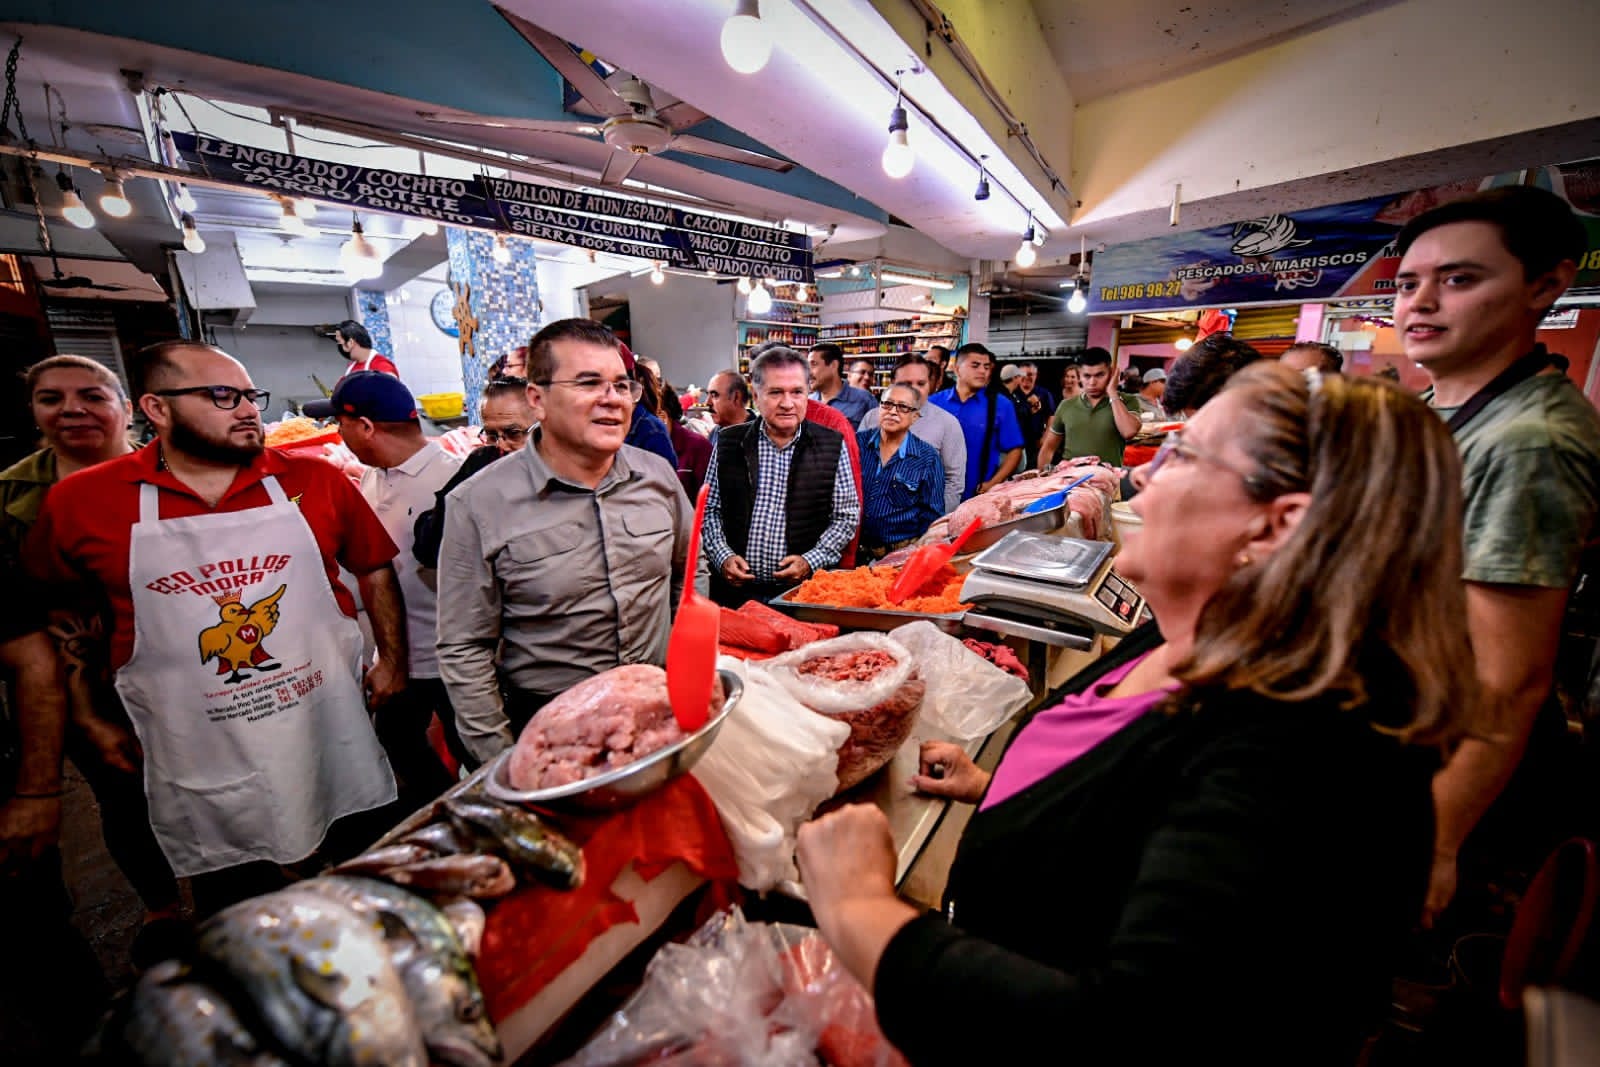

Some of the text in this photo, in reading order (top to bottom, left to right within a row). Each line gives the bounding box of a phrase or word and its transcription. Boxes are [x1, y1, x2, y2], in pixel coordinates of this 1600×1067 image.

[200, 139, 347, 180] LENGUADO
[366, 170, 467, 197] COCHITO
[244, 173, 351, 201] PARGO
[366, 197, 474, 225] BURRITO
[356, 183, 461, 212] BOTETE
[564, 192, 582, 210] DE
[511, 221, 576, 245] SIERRA
[580, 235, 616, 253] 100%
[741, 226, 790, 245] BOTETE
[737, 243, 791, 263] BURRITO
[1177, 263, 1254, 280] PESCADOS
[1260, 261, 1272, 273] Y
[1274, 251, 1367, 271] MARISCOS
[145, 555, 292, 595] ECO POLLOS
[241, 628, 254, 638] M
